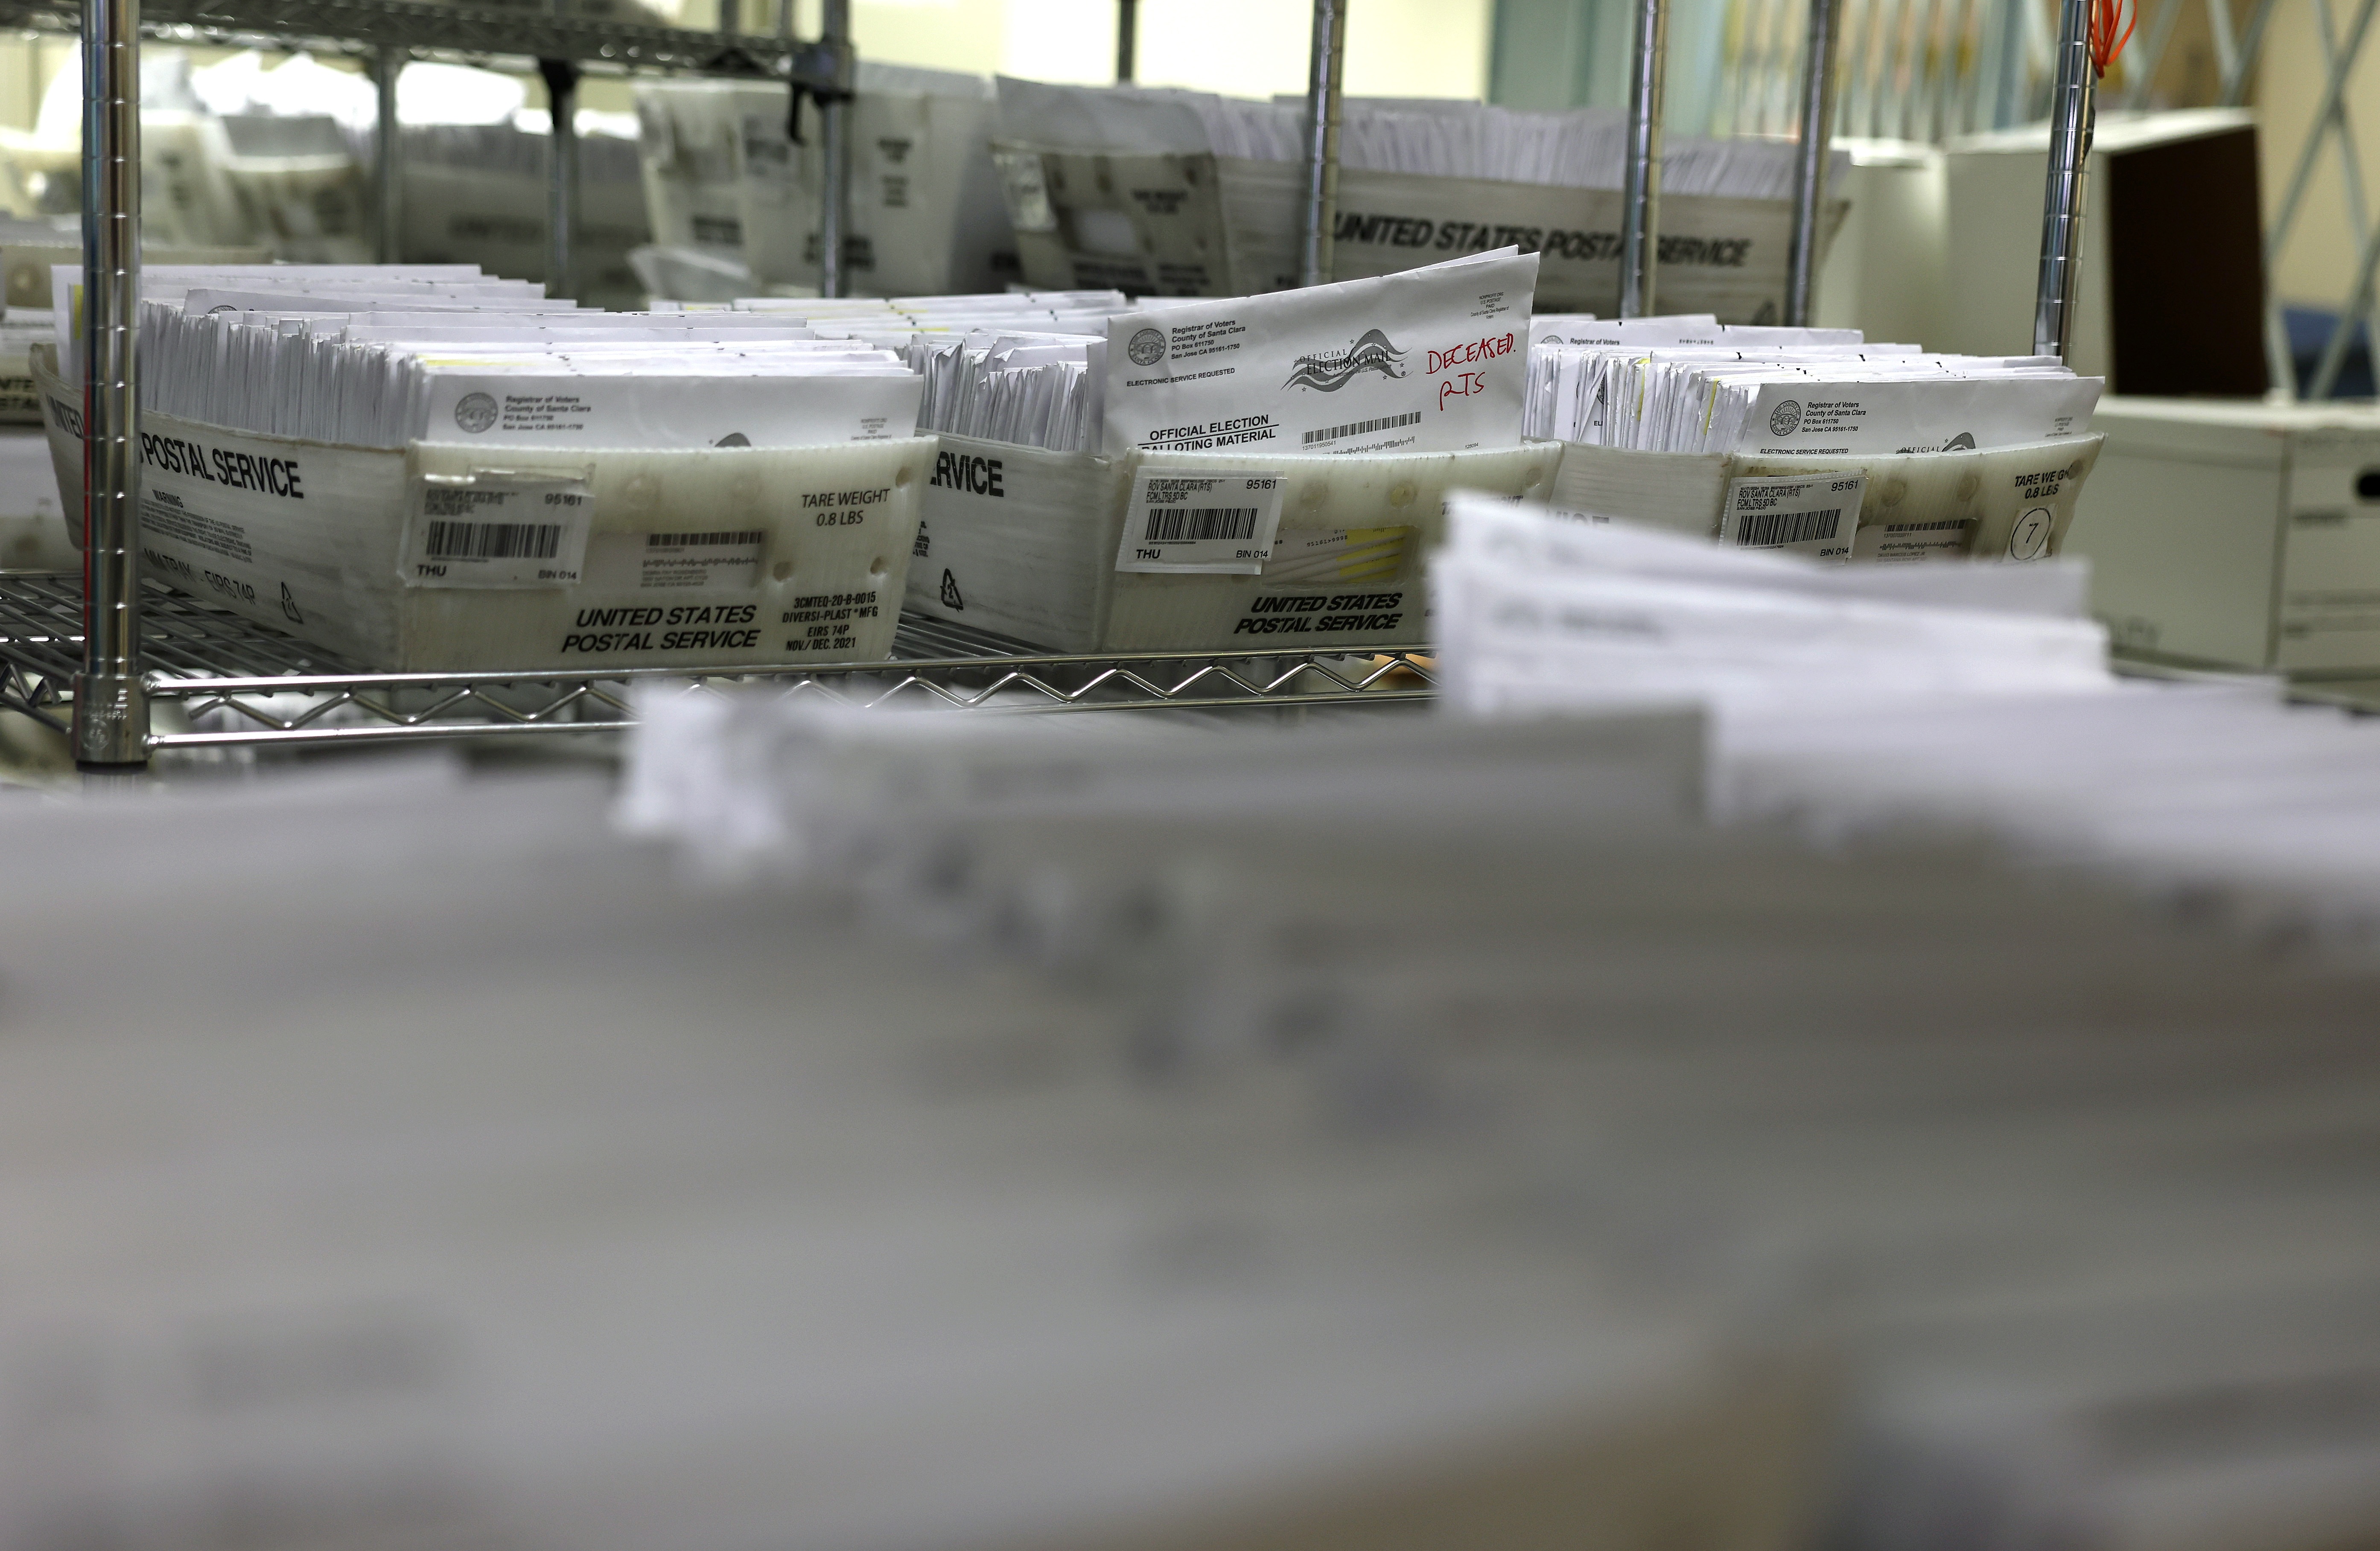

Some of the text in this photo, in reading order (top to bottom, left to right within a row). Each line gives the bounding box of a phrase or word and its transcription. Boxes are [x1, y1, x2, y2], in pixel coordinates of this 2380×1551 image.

[1542, 228, 1622, 260] POST
[1172, 325, 1204, 335] Registrar
[1172, 334, 1197, 343] County
[1207, 329, 1226, 338] Santa
[1228, 326, 1246, 334] Clara
[1208, 343, 1240, 353] 95161-1750
[1300, 349, 1347, 362] OFFICIAL
[1307, 350, 1391, 375] ELECTION MAIL
[1127, 367, 1235, 387] ELECTRONIC SERVICE REQUESTED
[506, 395, 543, 404] Registrar
[1150, 414, 1269, 441] OFFICIAL ELECTION
[1141, 429, 1276, 452] OTING MATERIAL
[1302, 440, 1336, 451] 137011950541
[142, 432, 304, 499] POSTAL SERVICE
[930, 451, 1004, 498] RVICE
[2015, 473, 2040, 487] TARE
[1148, 482, 1213, 493] ROV SANTA CLARA (RTS)
[1246, 479, 1277, 490] 95161
[1831, 480, 1858, 491] 95161
[152, 489, 184, 508] WARNING
[545, 493, 582, 506] 95161
[802, 488, 890, 509] TARE WEIGHT
[1180, 492, 1188, 500] BC
[1751, 490, 1768, 498] SANTA
[1769, 490, 1786, 498] CLARA
[1787, 489, 1800, 498] (RTS)
[2024, 487, 2040, 499] 0.8
[817, 510, 864, 527] 0.8 LBS
[1136, 549, 1268, 560] THU BIN 014
[1820, 547, 1849, 557] BIN 014
[417, 564, 577, 580] THU BIN 014
[1251, 592, 1403, 613] UNITED STATES
[576, 604, 757, 627] UNITED STATES
[782, 608, 852, 623] DIVERSI-PLAST
[1234, 613, 1403, 634] POSTAL SERVICE
[807, 624, 850, 638] EIRS 74P
[561, 629, 762, 653] POSTAL SERVICE
[812, 639, 831, 650] DEC.
[833, 637, 857, 650] 2021
